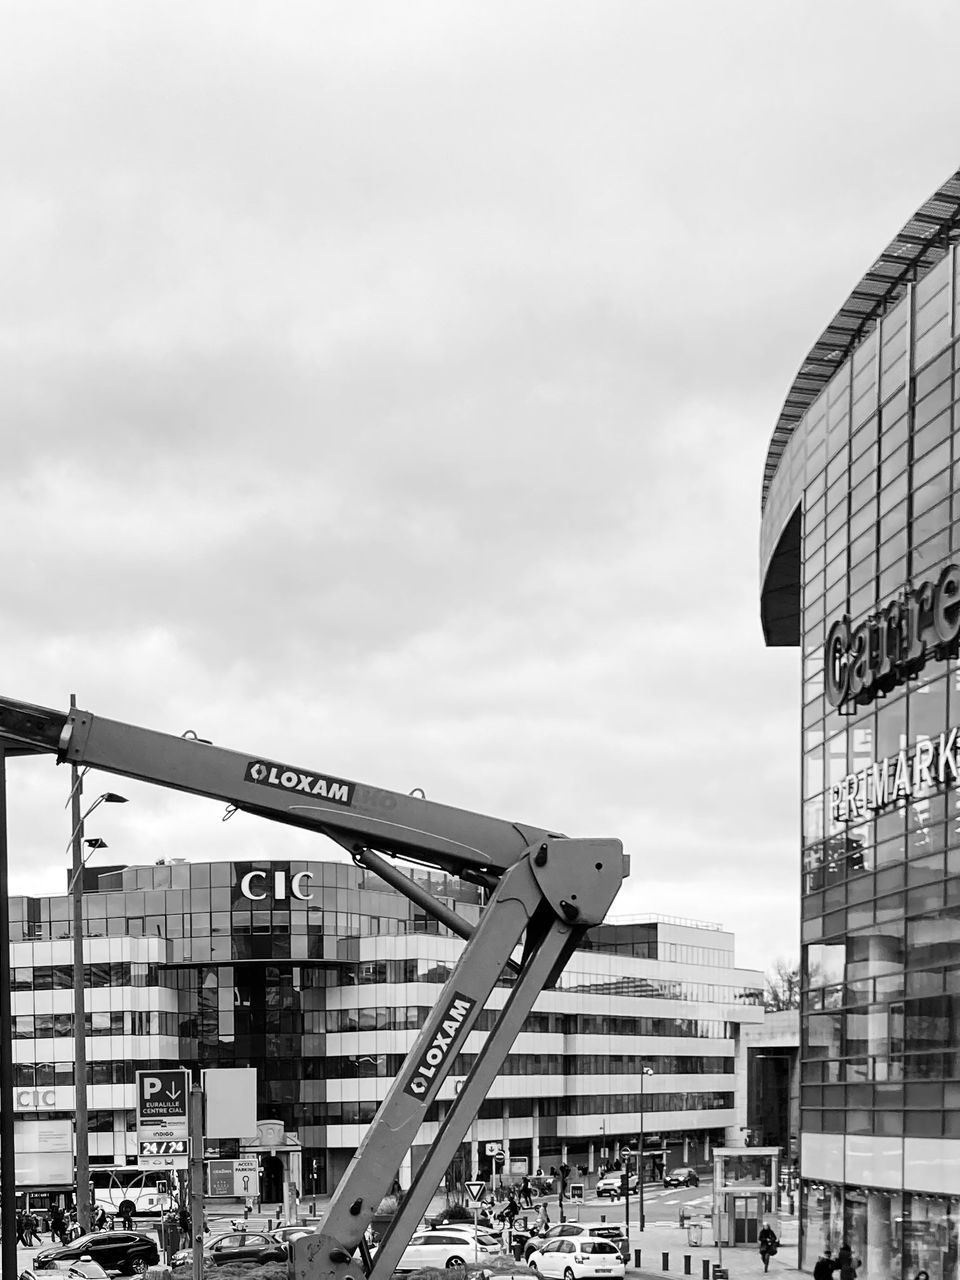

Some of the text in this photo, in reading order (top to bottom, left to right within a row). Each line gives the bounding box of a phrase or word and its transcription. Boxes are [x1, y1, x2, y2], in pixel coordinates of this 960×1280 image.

[268, 767, 349, 802] LOXAM
[830, 727, 958, 826] PRIMARK
[240, 870, 314, 900] CIC
[418, 999, 471, 1078] LOXAM
[18, 1090, 56, 1107] CIC
[143, 1077, 162, 1100] P
